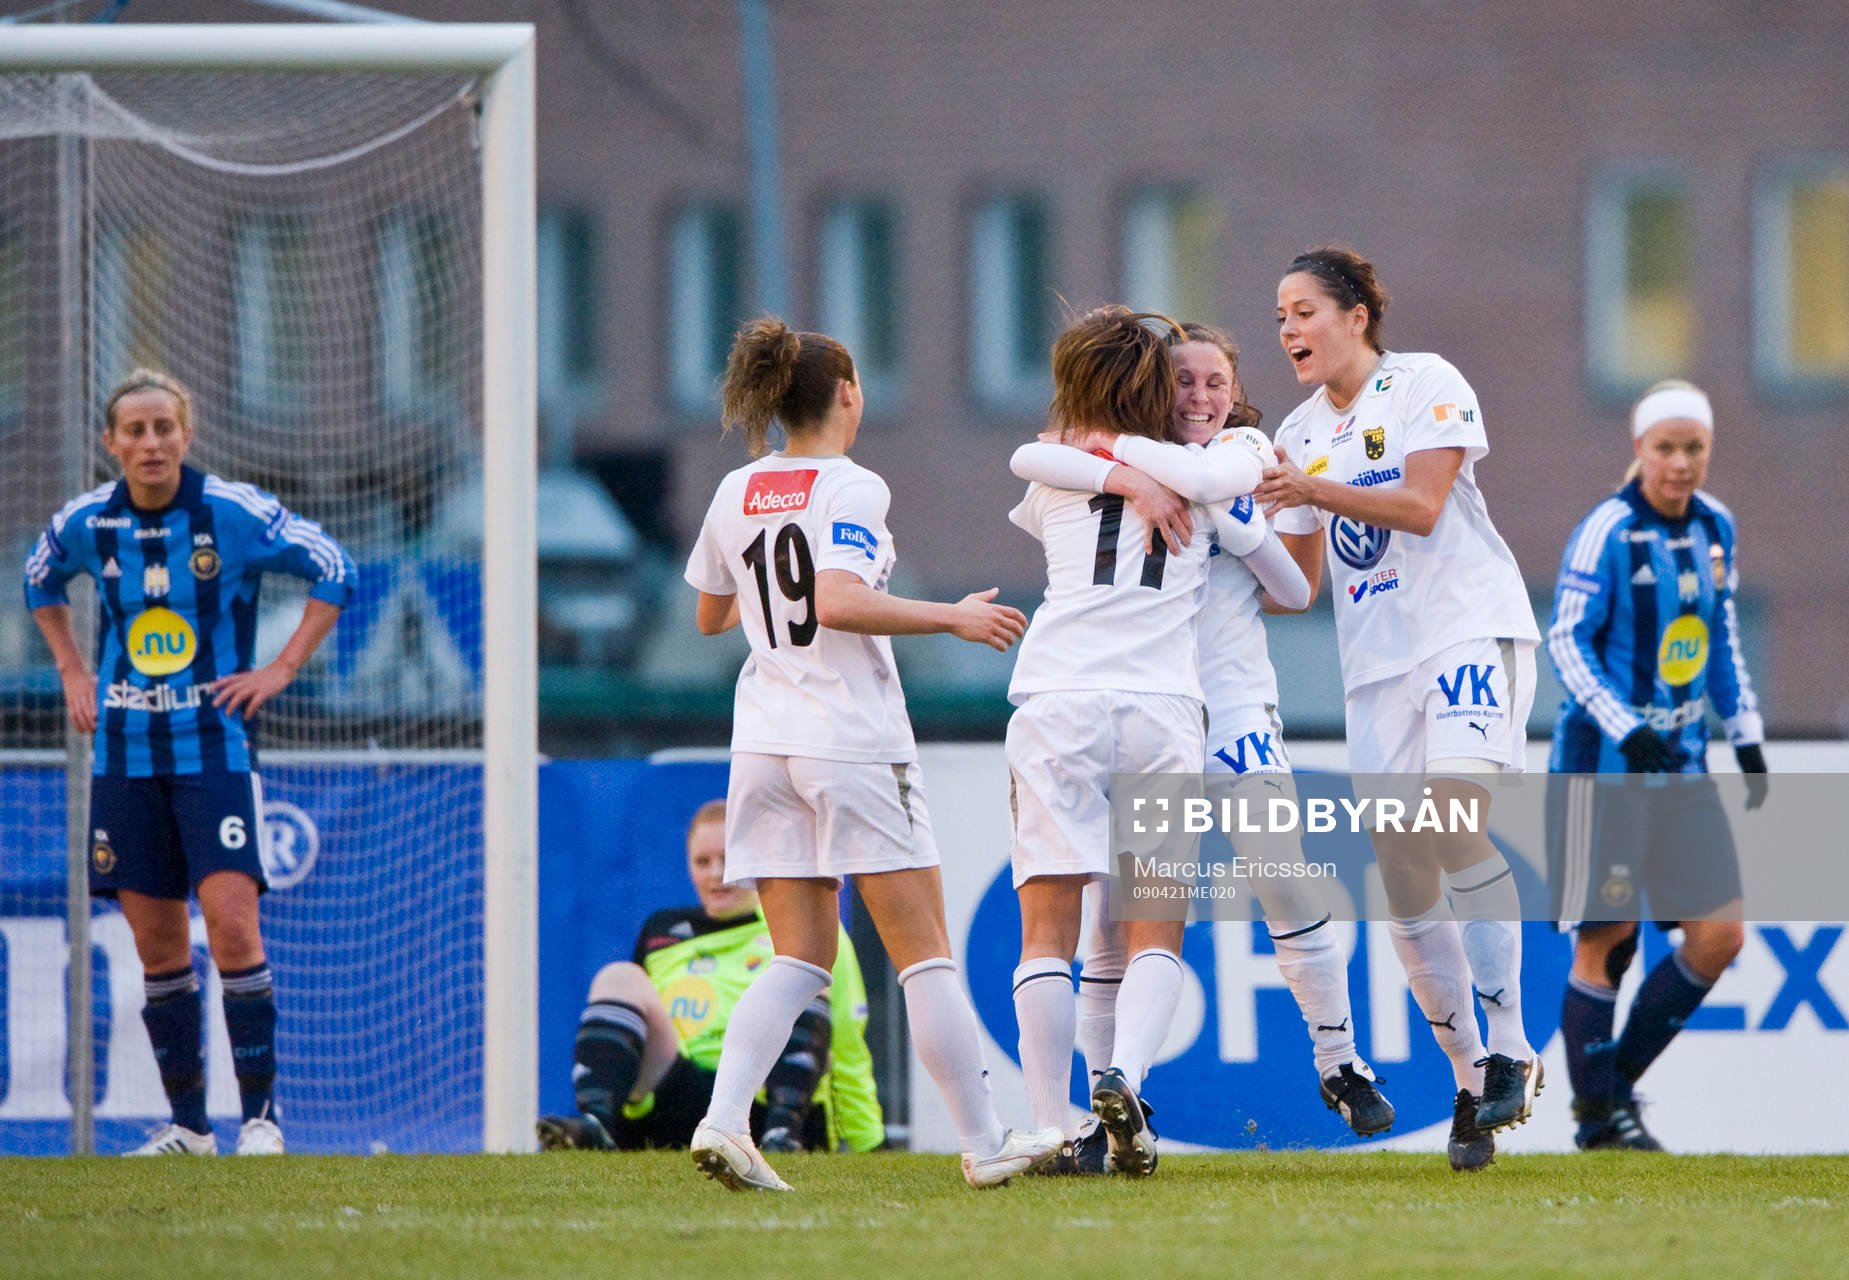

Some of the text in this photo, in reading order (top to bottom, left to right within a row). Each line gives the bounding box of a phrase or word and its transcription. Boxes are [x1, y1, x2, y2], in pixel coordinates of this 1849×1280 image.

[1346, 467, 1401, 487] sjöhus
[748, 491, 806, 511] Adecco
[741, 522, 819, 650] 19
[1369, 578, 1399, 597] SPORT
[136, 631, 187, 656] .nu
[1436, 664, 1500, 708] VK
[1212, 731, 1285, 777] VK
[219, 815, 247, 849] 6
